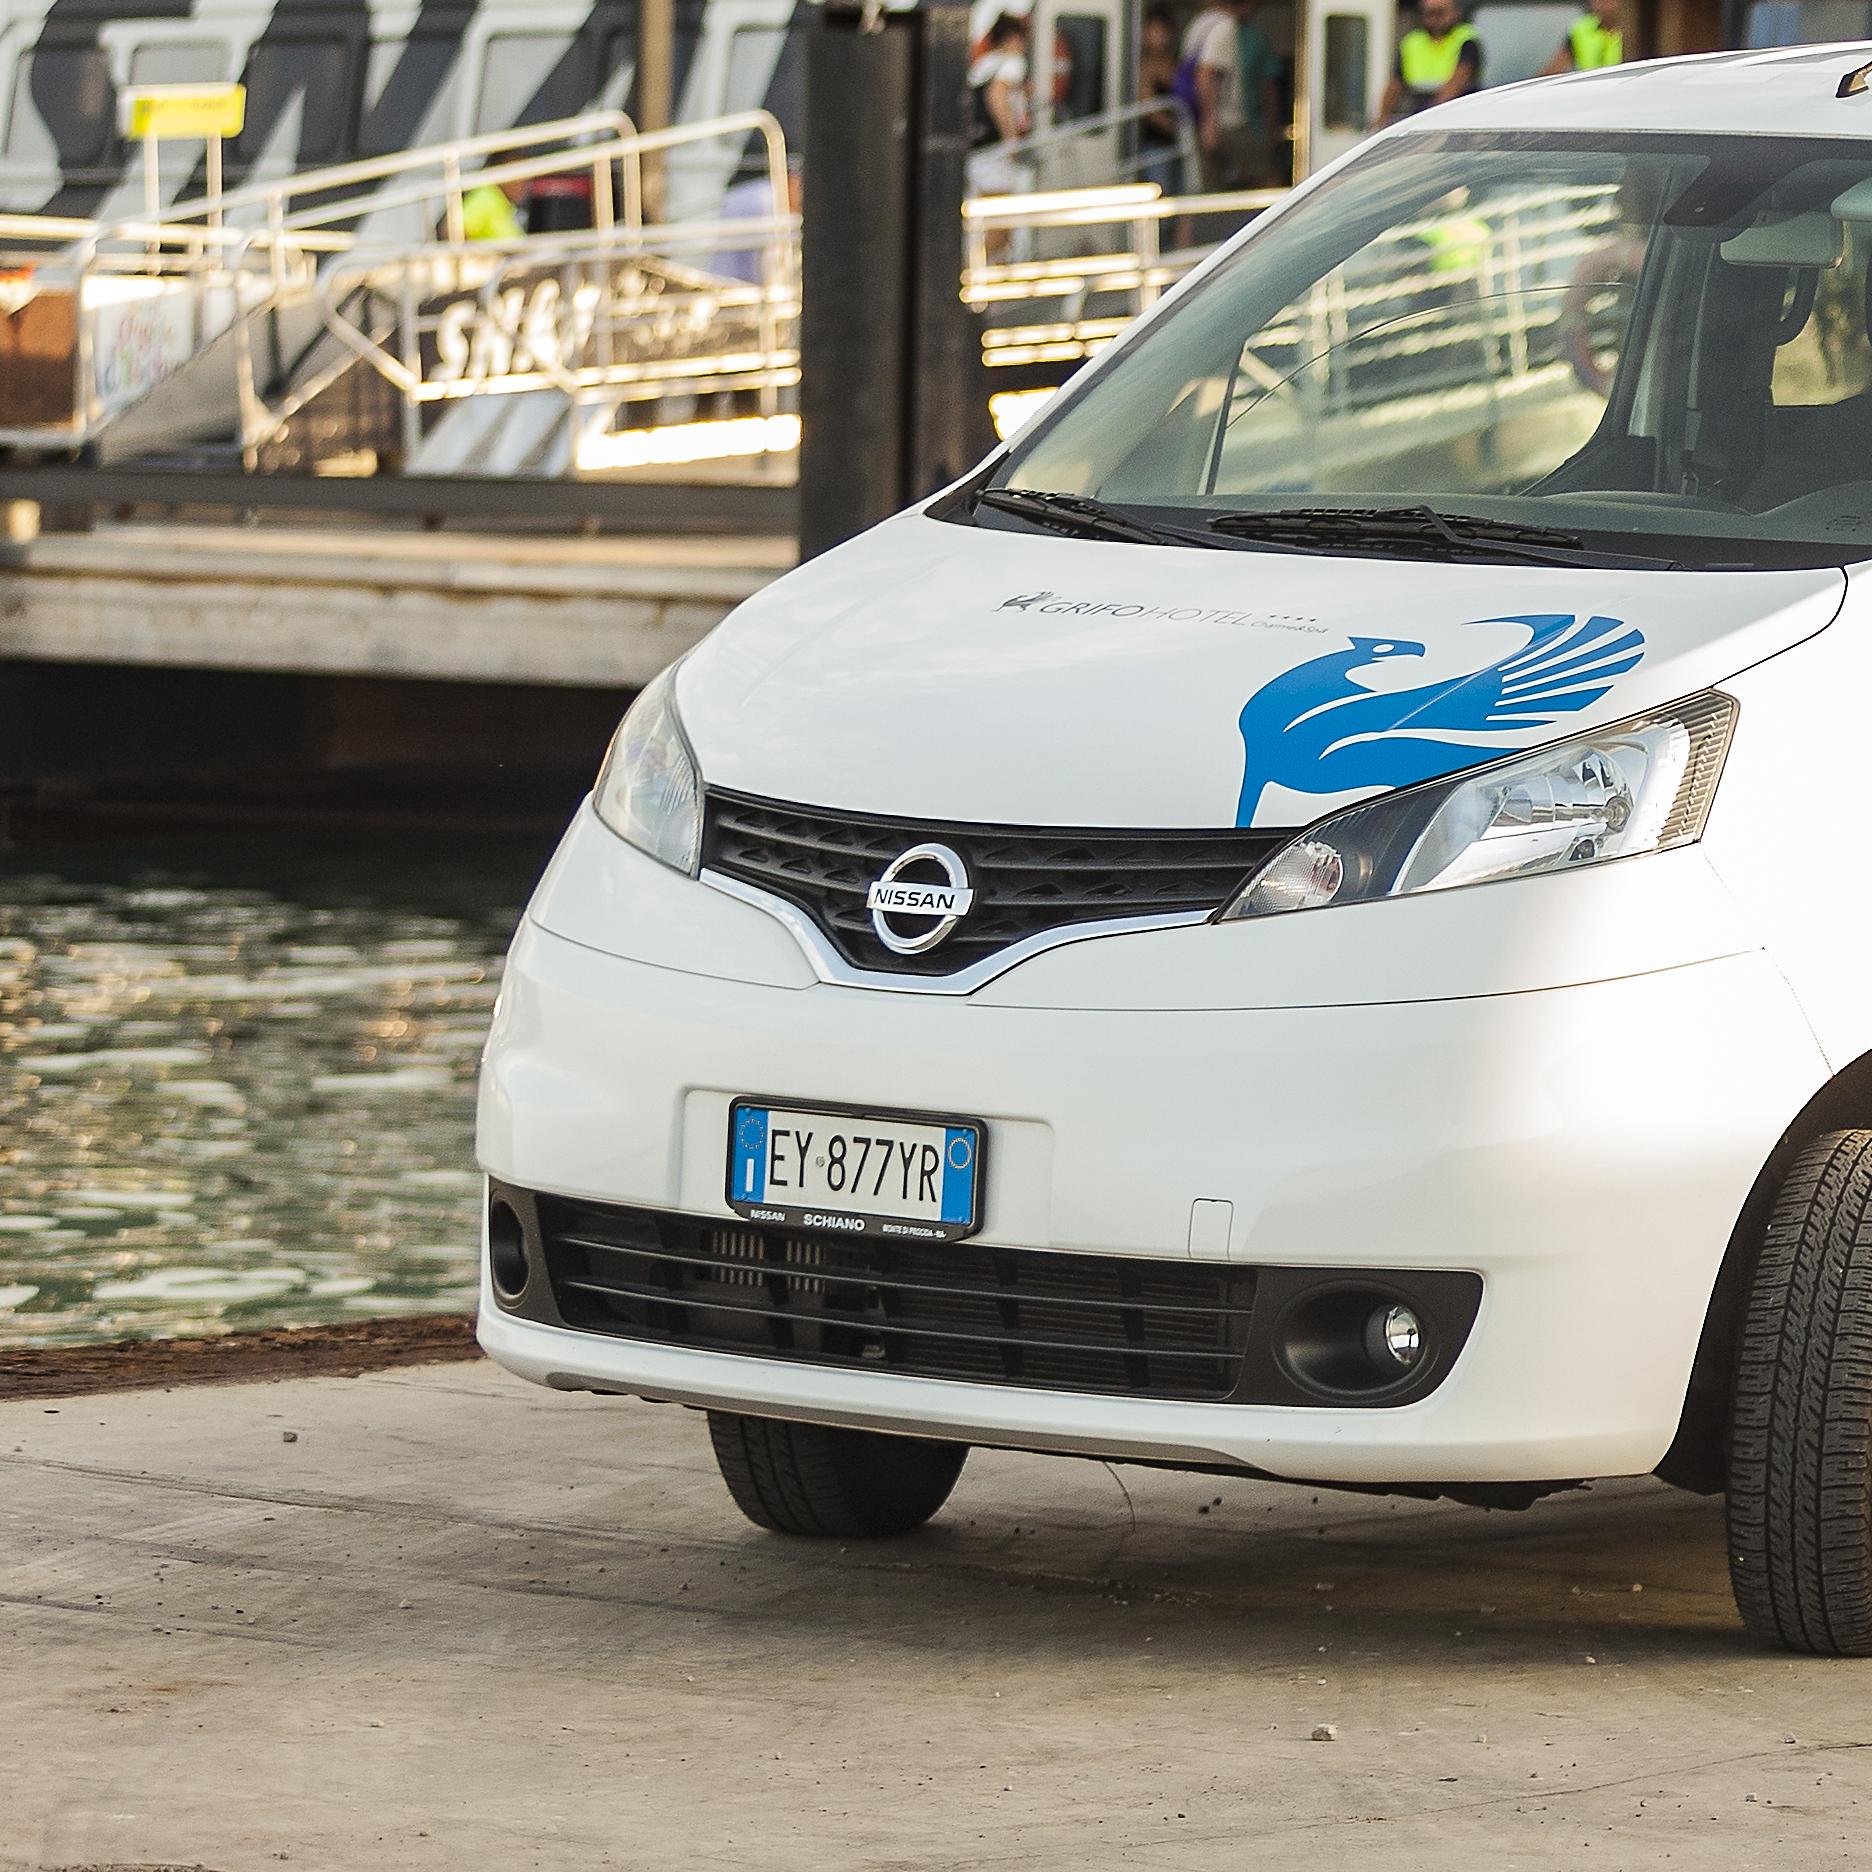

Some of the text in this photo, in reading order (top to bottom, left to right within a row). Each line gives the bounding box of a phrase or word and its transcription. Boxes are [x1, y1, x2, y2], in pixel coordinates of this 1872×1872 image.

[873, 888, 956, 910] NISSAN
[826, 1134, 940, 1203] 877YR
[750, 1209, 787, 1223] NISSAN
[802, 1212, 866, 1232] SCHIANO
